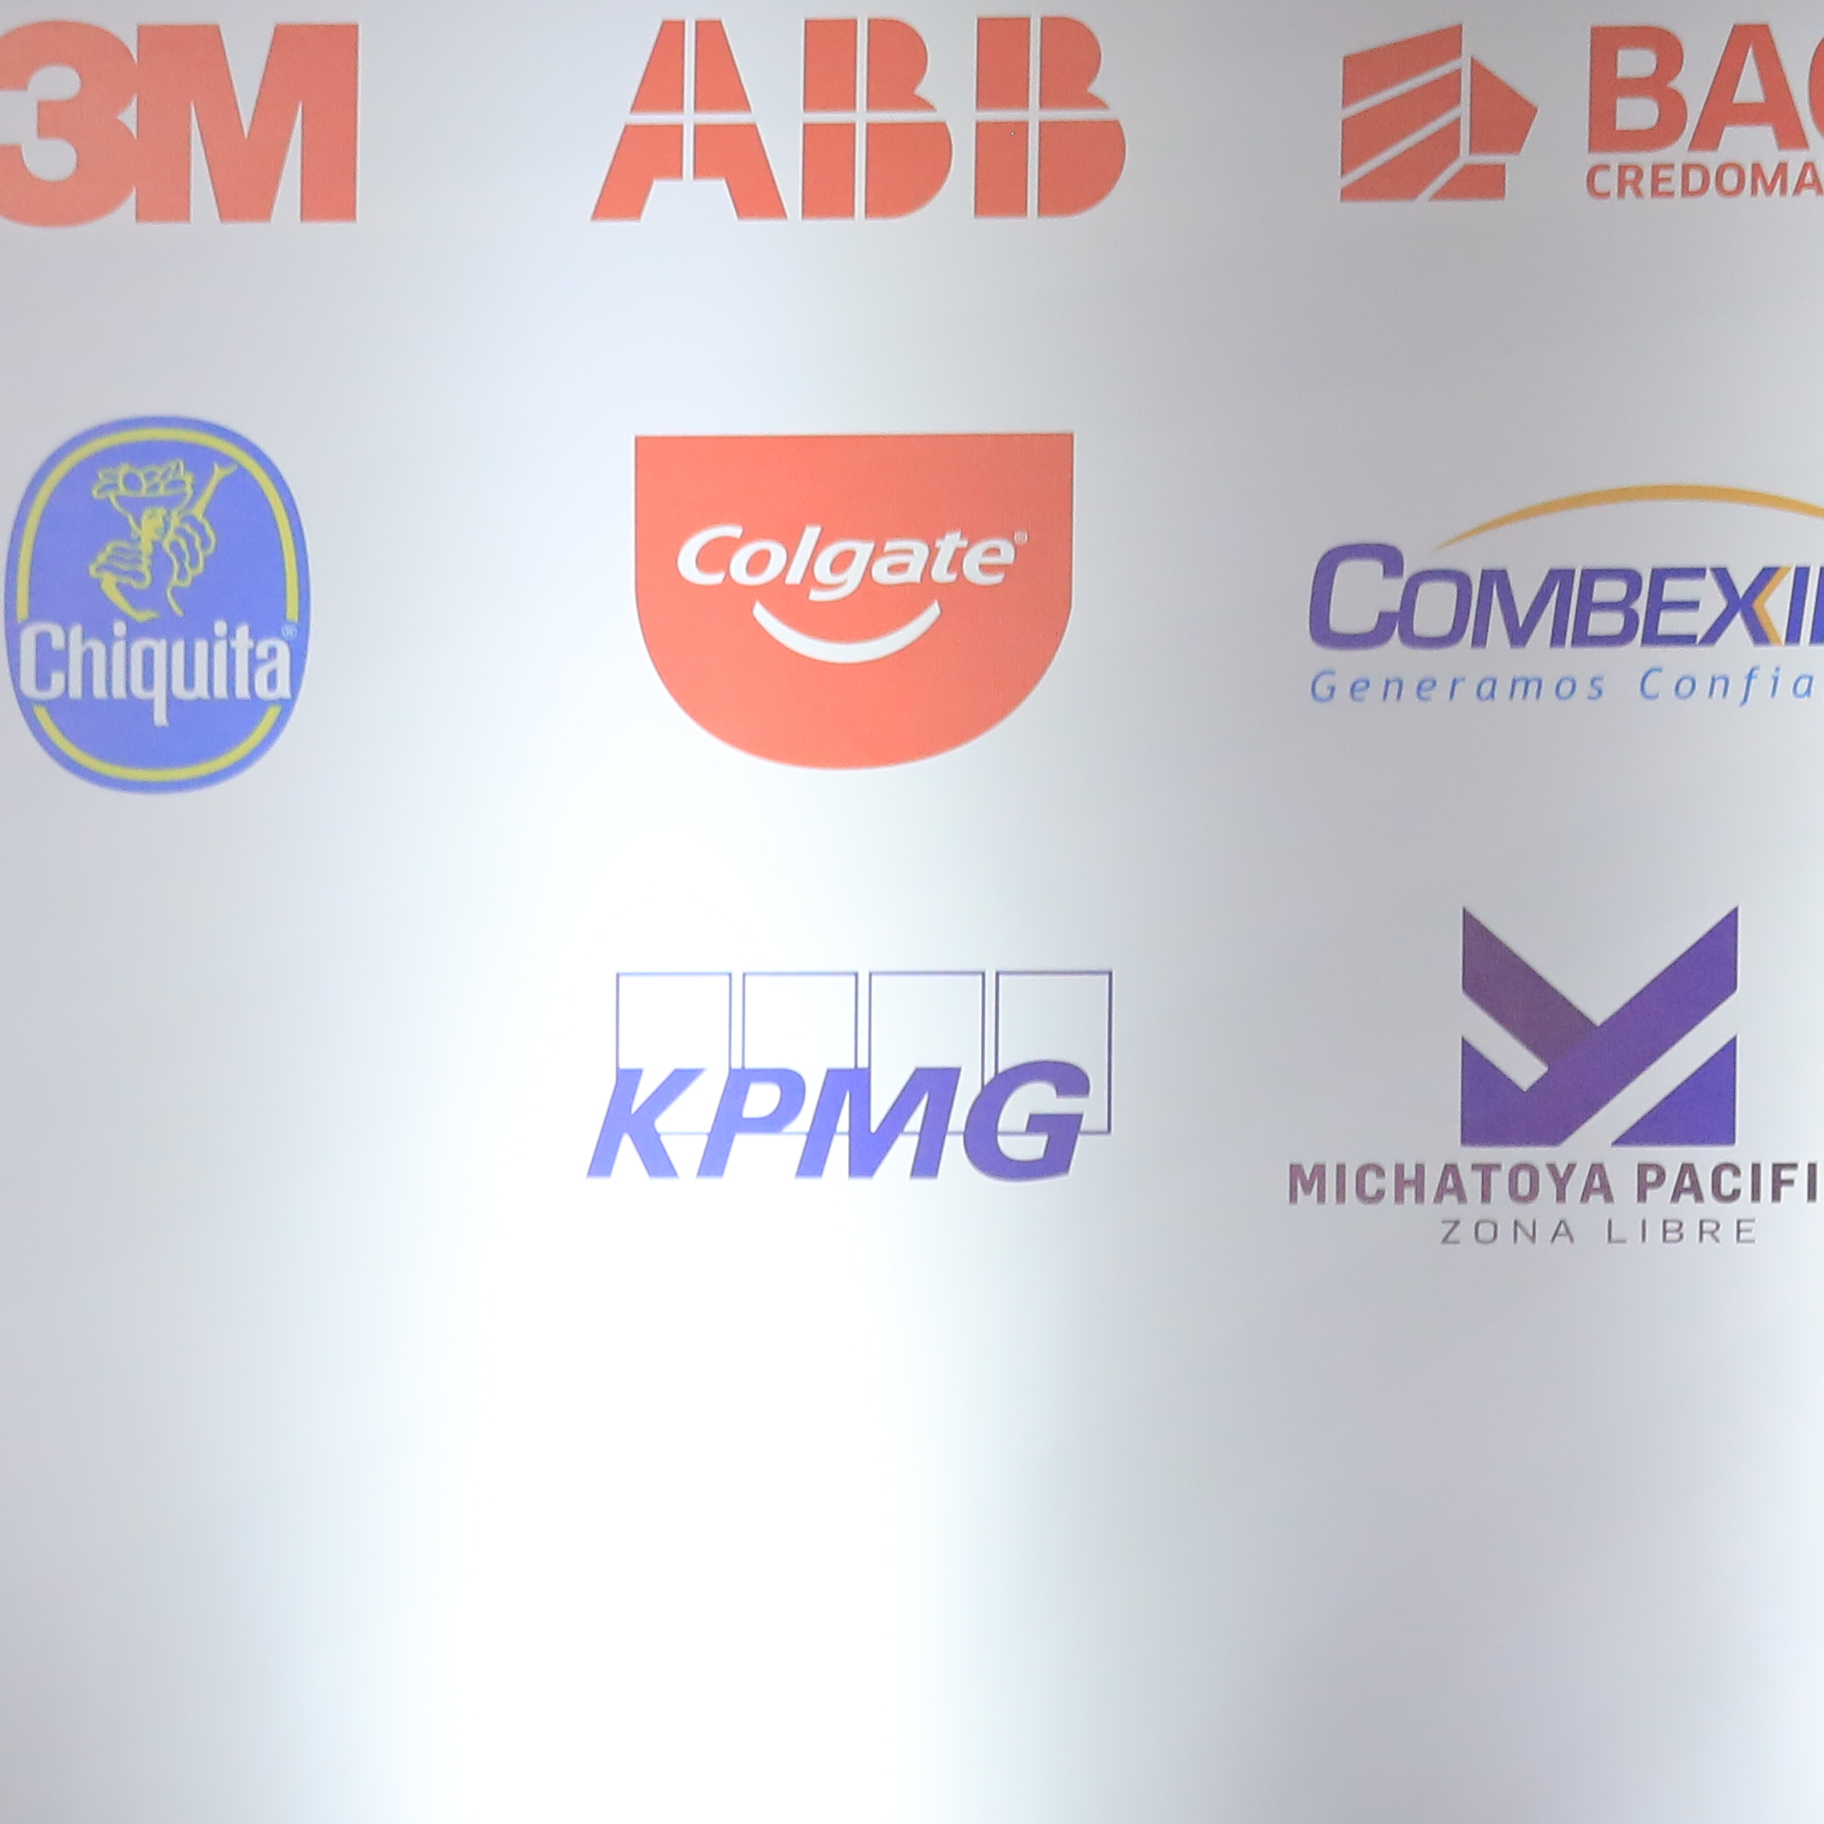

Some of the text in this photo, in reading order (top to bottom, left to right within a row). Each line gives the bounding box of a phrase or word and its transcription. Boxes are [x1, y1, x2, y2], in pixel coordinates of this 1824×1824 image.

[592, 15, 1127, 221] ABB
[1587, 22, 1824, 154] BA
[1586, 161, 1824, 200] CREDOMA
[1309, 541, 1824, 651] COMBEXI
[19, 618, 293, 727] Chiquita
[1310, 666, 1816, 708] Generamos Confia
[585, 1060, 1092, 1183] KPMG
[1288, 1161, 1819, 1206] MICHATOYA PACIFI
[1440, 1217, 1757, 1246] ZONA LIBRE
